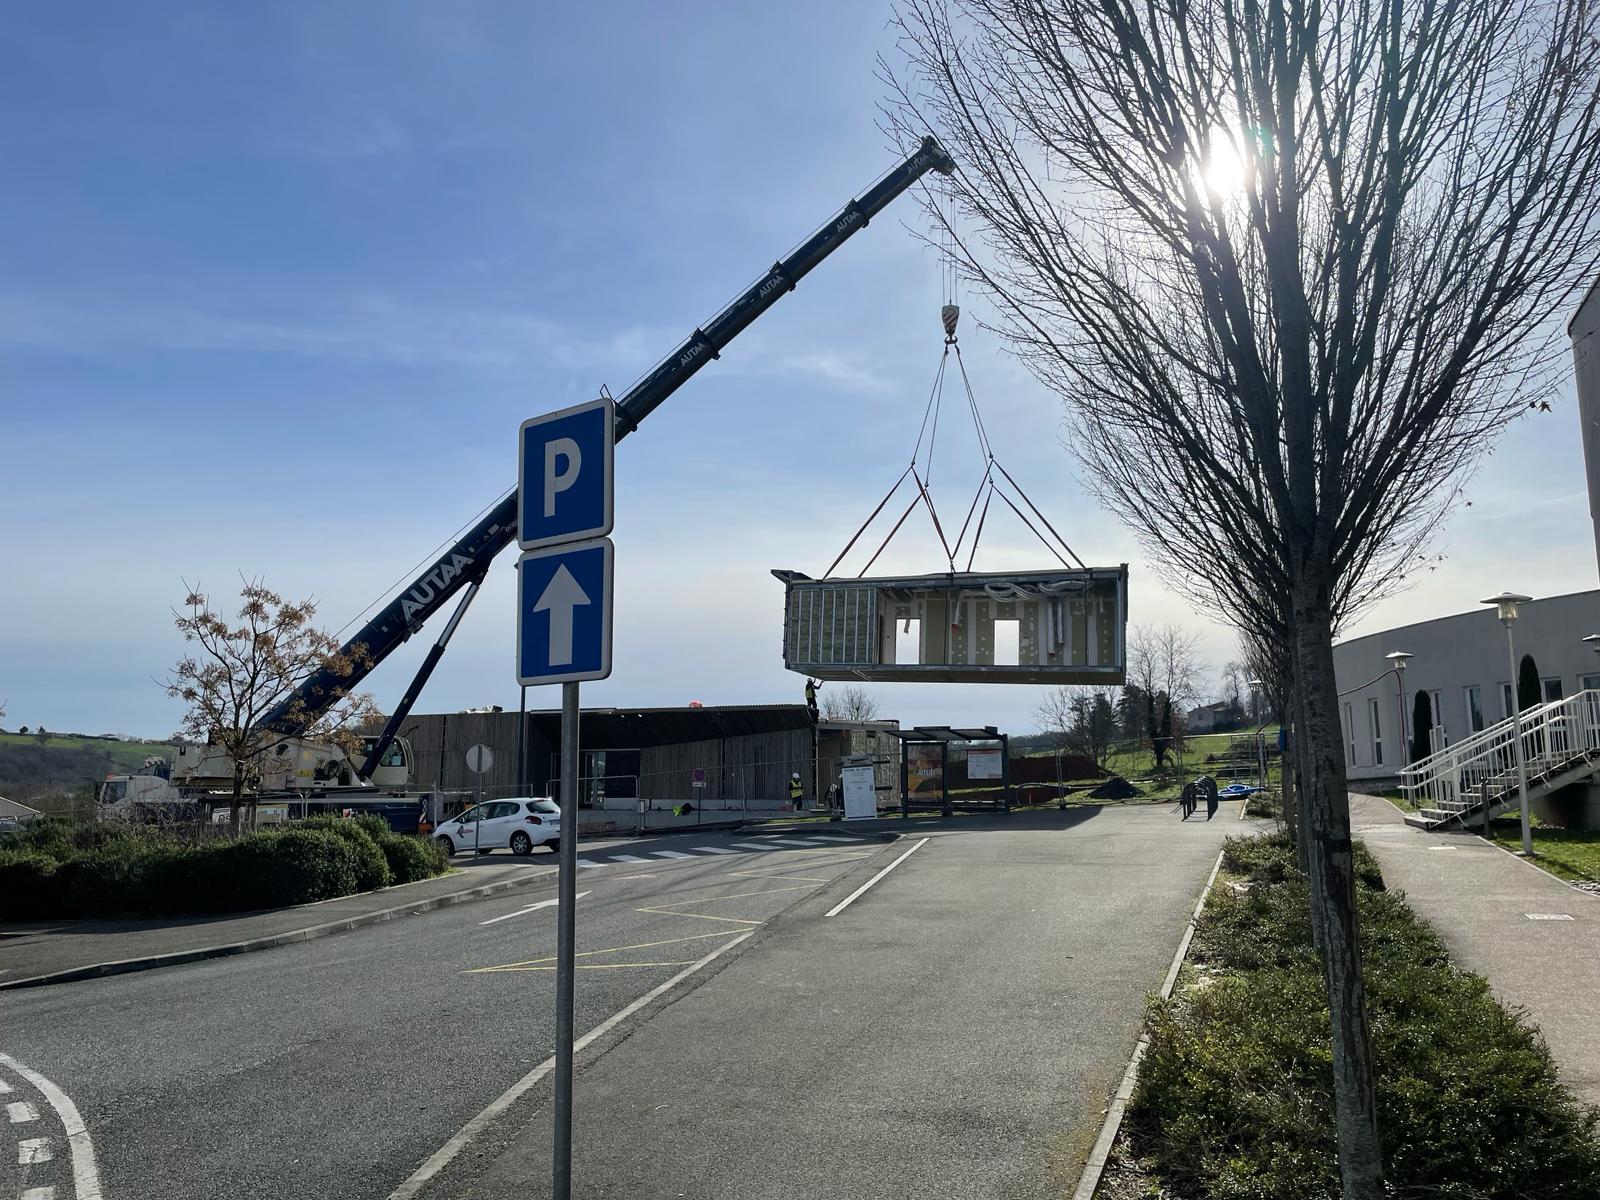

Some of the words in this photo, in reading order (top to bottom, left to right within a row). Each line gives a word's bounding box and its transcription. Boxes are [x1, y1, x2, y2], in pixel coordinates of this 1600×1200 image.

[836, 211, 860, 232] AUTAA
[759, 275, 784, 298] AUTAA
[680, 342, 707, 367] AUTAA
[544, 437, 582, 517] P
[400, 553, 475, 620] AUTAA
